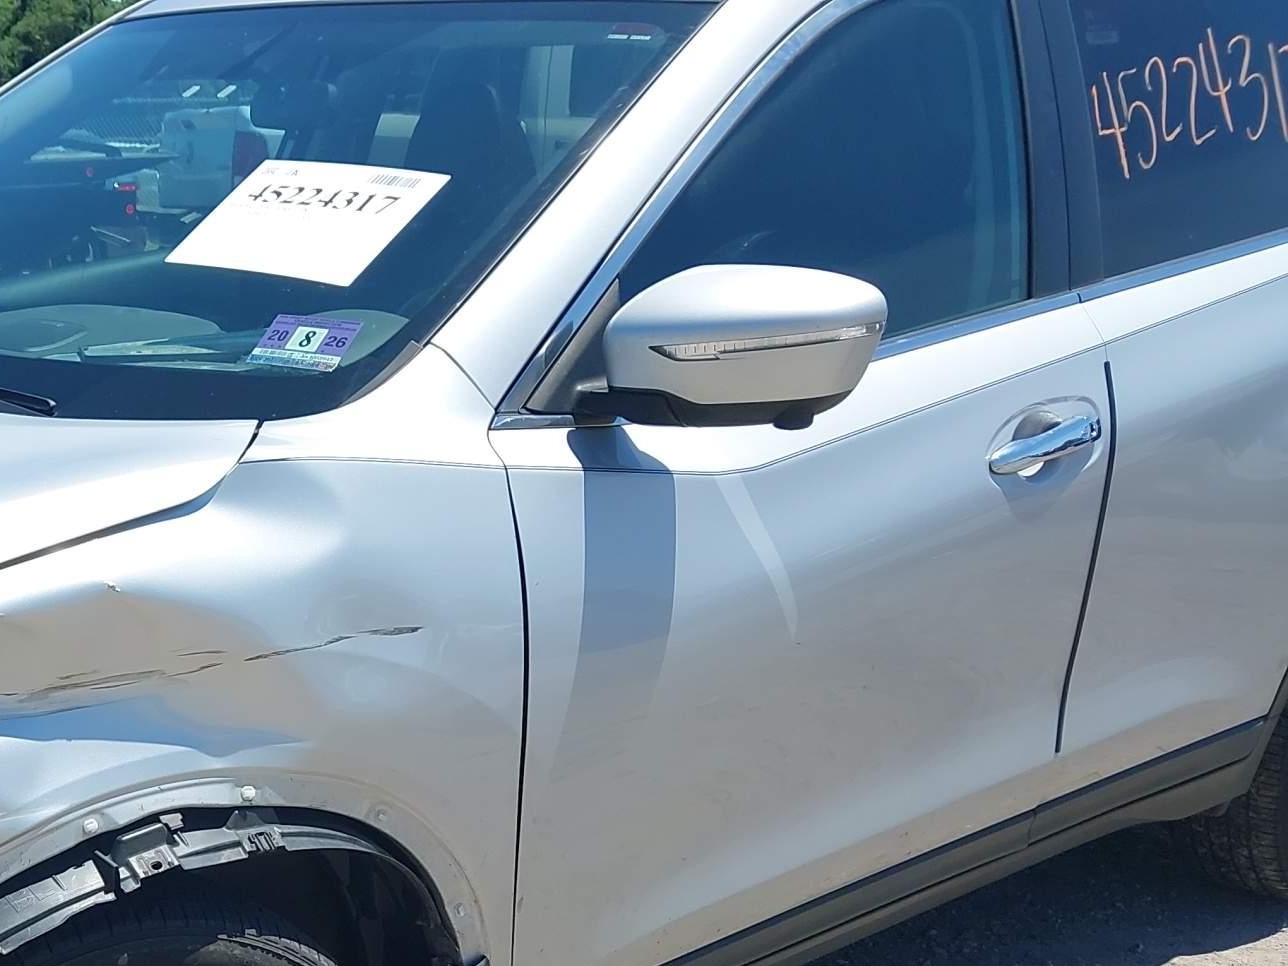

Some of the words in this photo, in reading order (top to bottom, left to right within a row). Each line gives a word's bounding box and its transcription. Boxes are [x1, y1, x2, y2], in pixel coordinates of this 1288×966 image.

[1092, 27, 1288, 180] 4522431
[248, 184, 402, 215] 45224317
[267, 329, 289, 342] 20
[298, 330, 317, 347] 8
[324, 335, 348, 348] 26
